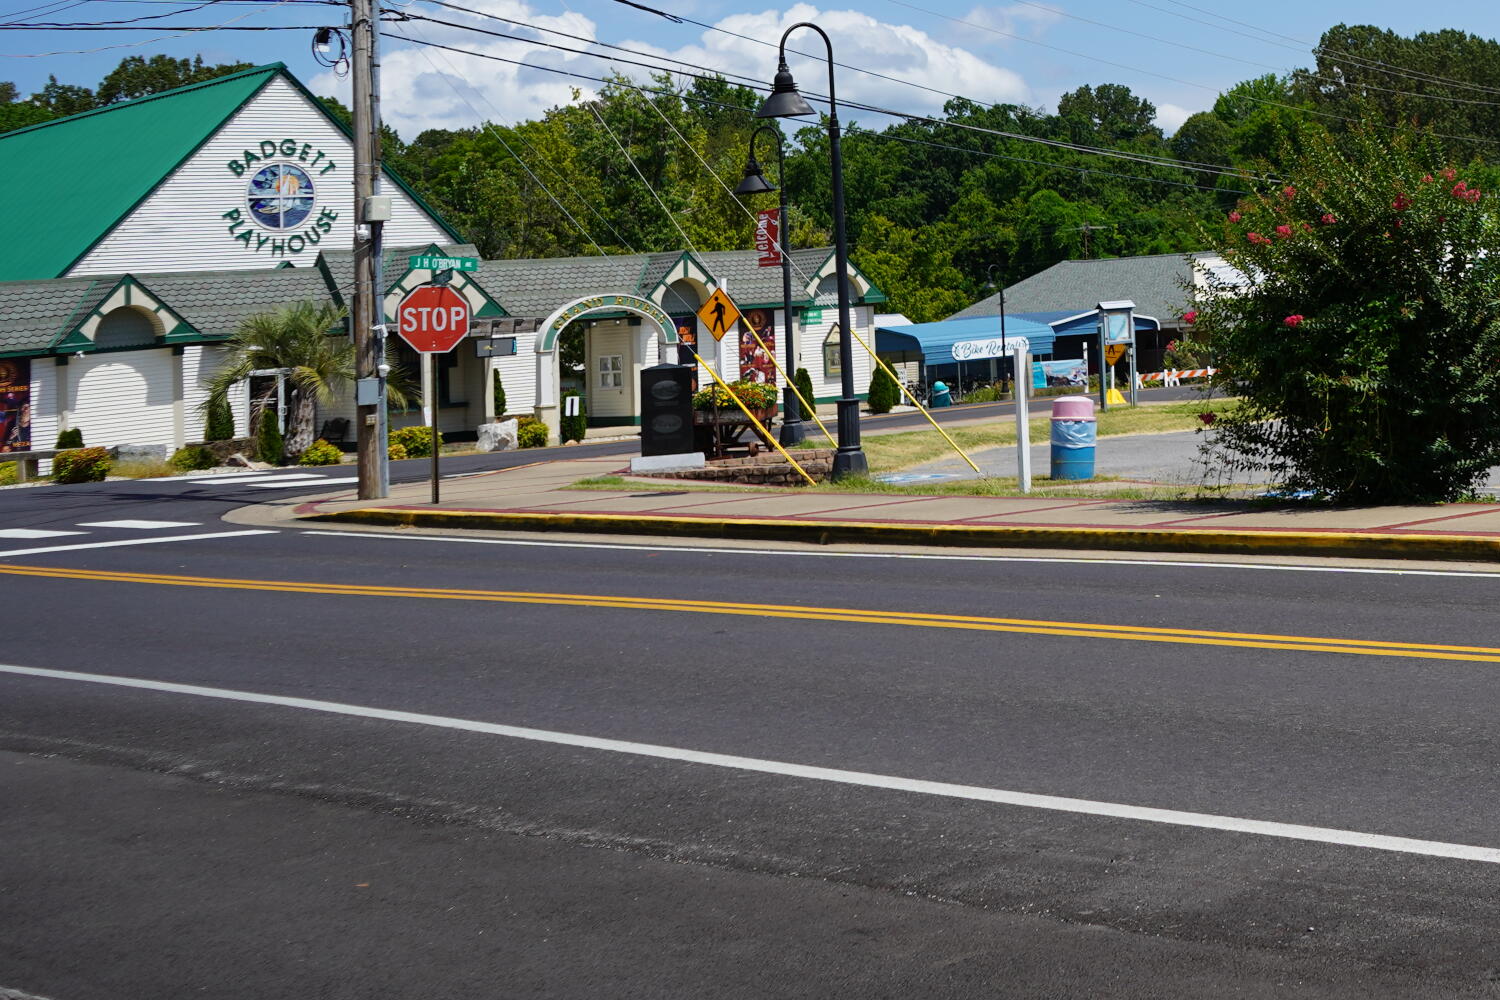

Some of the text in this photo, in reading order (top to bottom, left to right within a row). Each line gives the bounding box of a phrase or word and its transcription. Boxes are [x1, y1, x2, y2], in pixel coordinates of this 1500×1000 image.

[227, 138, 337, 177] BADGETT
[222, 206, 339, 257] PLAYHOUSE
[402, 306, 466, 332] STOP
[554, 295, 666, 330] GRAND RIVERS
[961, 342, 983, 358] Bike
